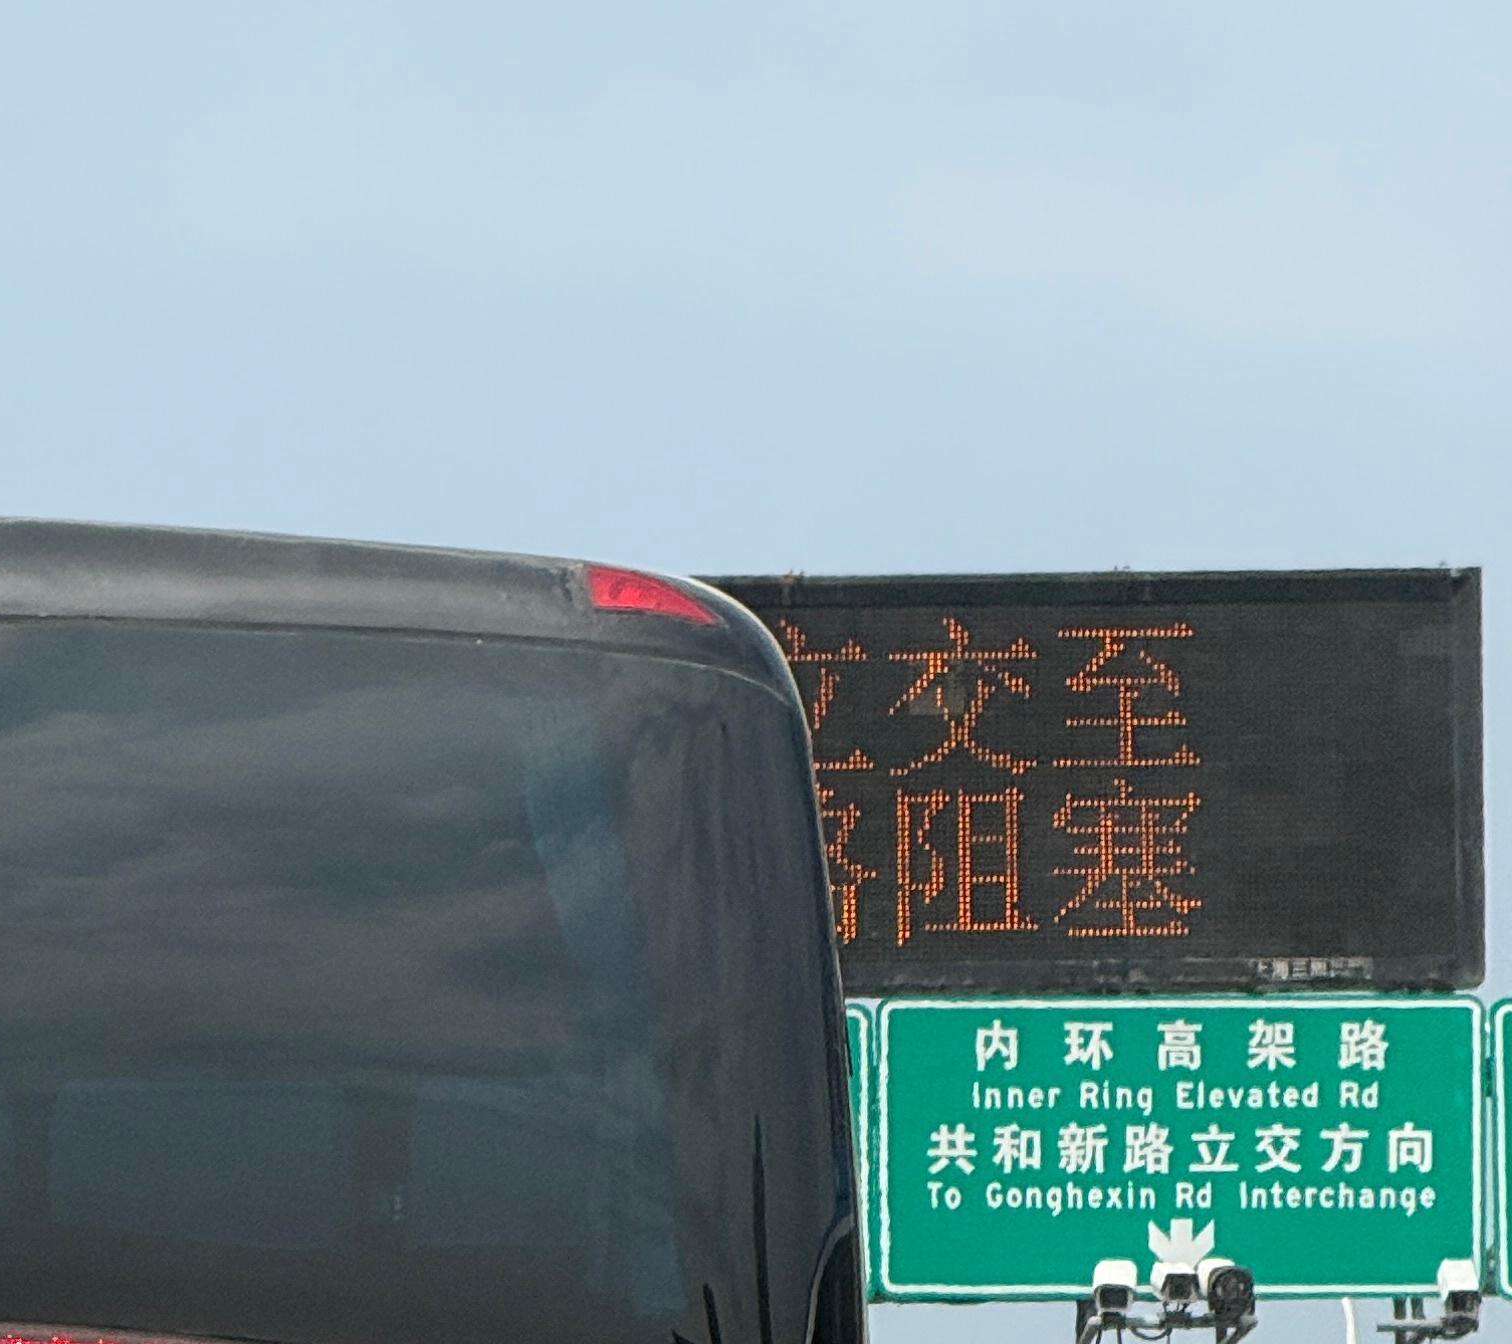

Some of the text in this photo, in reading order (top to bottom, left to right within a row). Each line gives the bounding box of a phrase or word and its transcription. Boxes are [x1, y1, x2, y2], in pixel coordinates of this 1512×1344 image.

[975, 1018, 1389, 1072] 内环高架路
[972, 1081, 1379, 1116] Inner Ring Elevated Rd
[927, 1121, 1434, 1174] 共和新路立交方向
[927, 1181, 1436, 1216] To Gonghexin Rd Interchange
